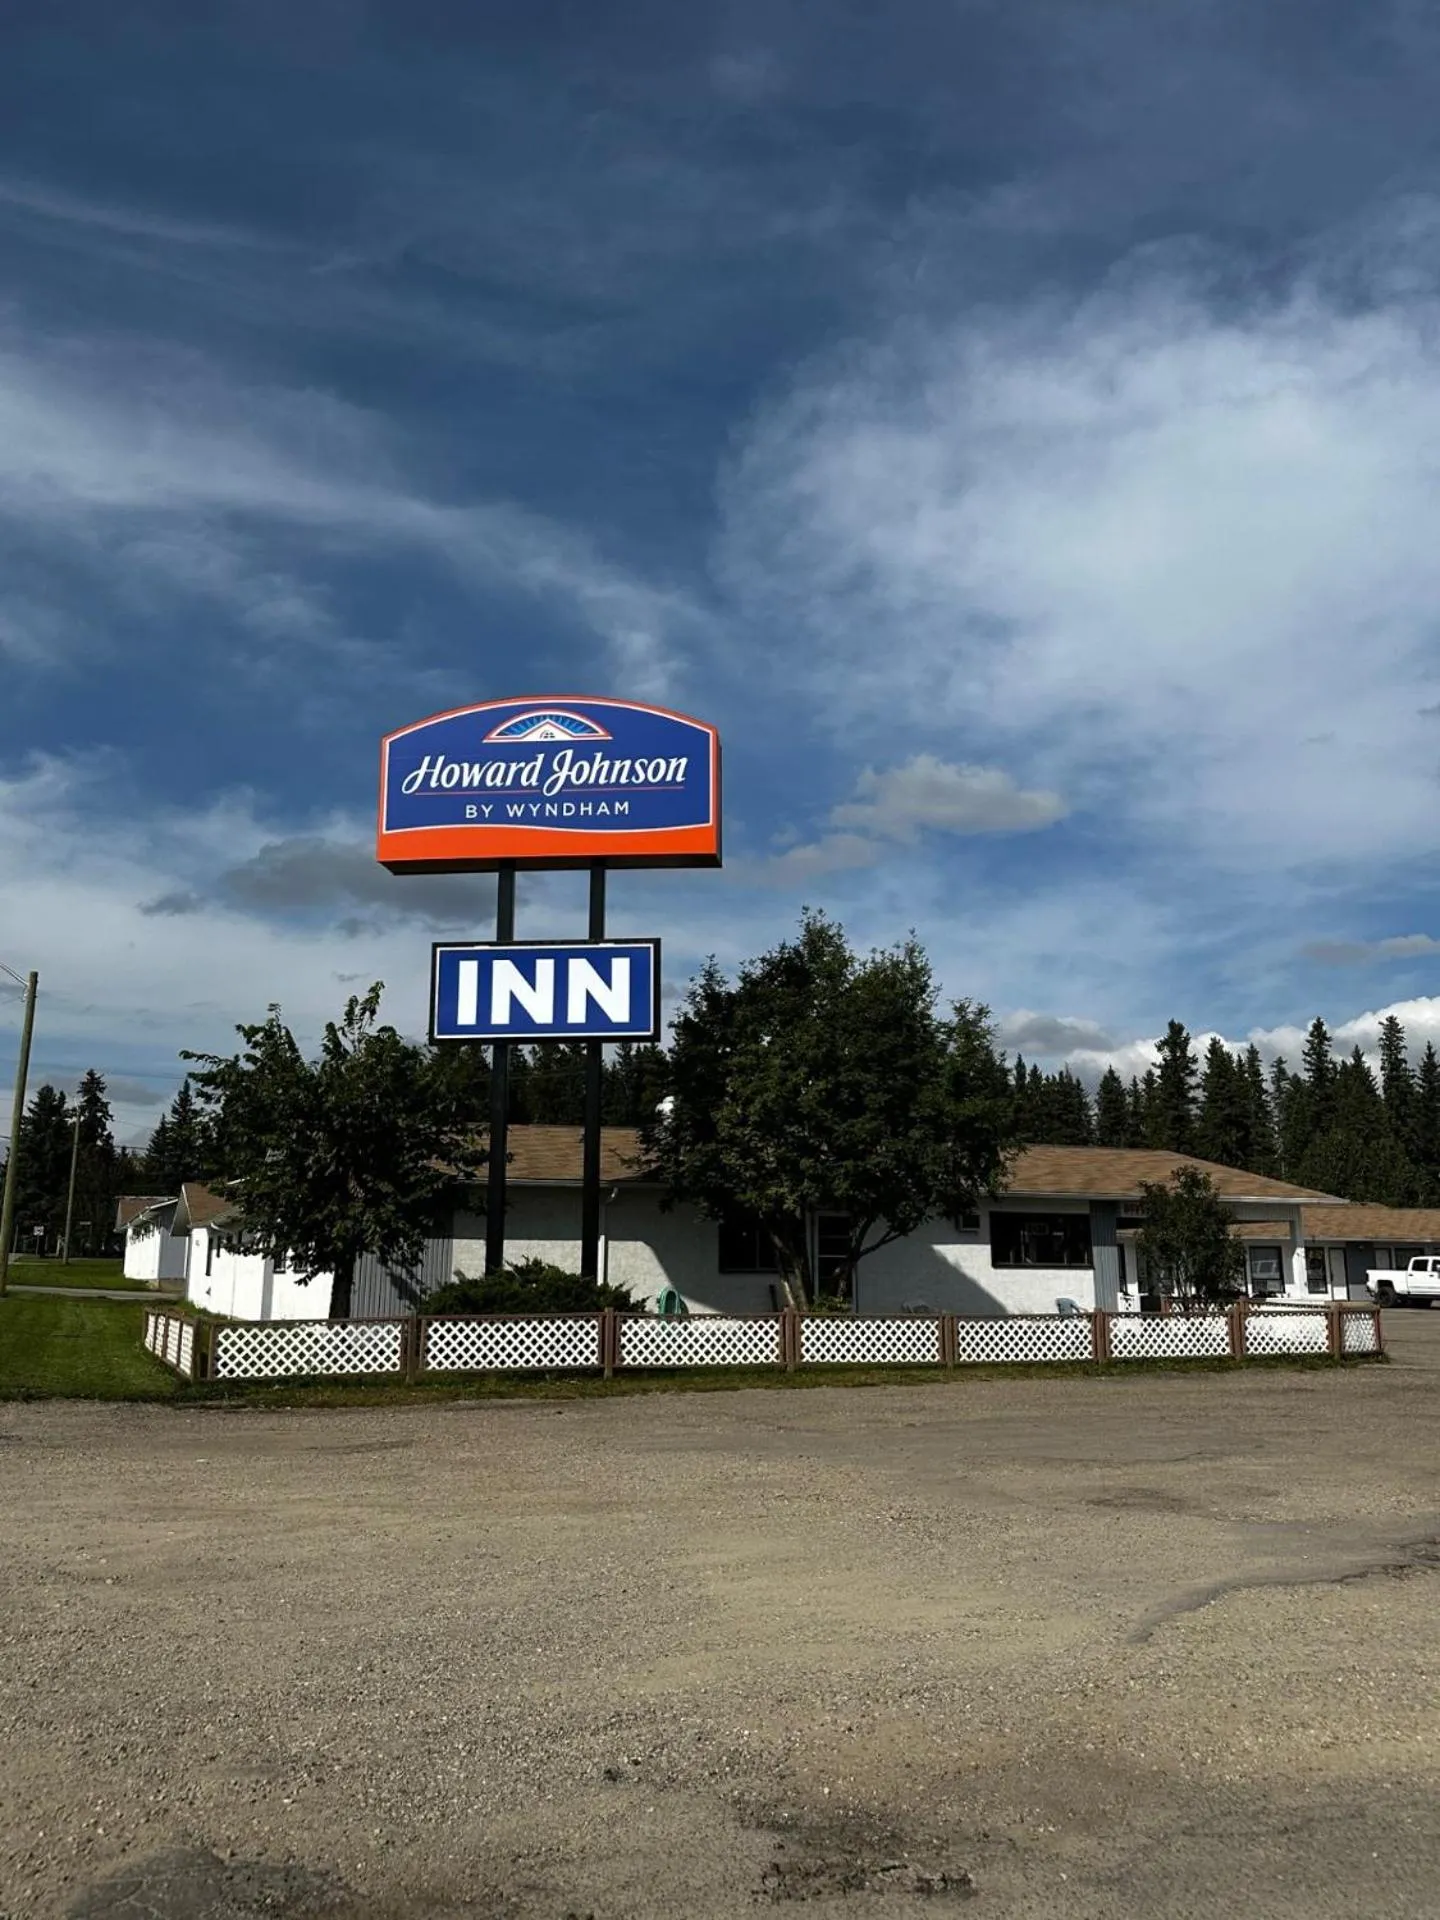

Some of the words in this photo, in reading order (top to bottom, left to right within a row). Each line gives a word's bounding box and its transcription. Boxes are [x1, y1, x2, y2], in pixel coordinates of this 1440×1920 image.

[402, 754, 544, 794] Howard
[543, 750, 688, 797] Johnson
[465, 804, 494, 819] BY
[506, 801, 629, 818] WYNDHAM
[457, 957, 630, 1025] INN
